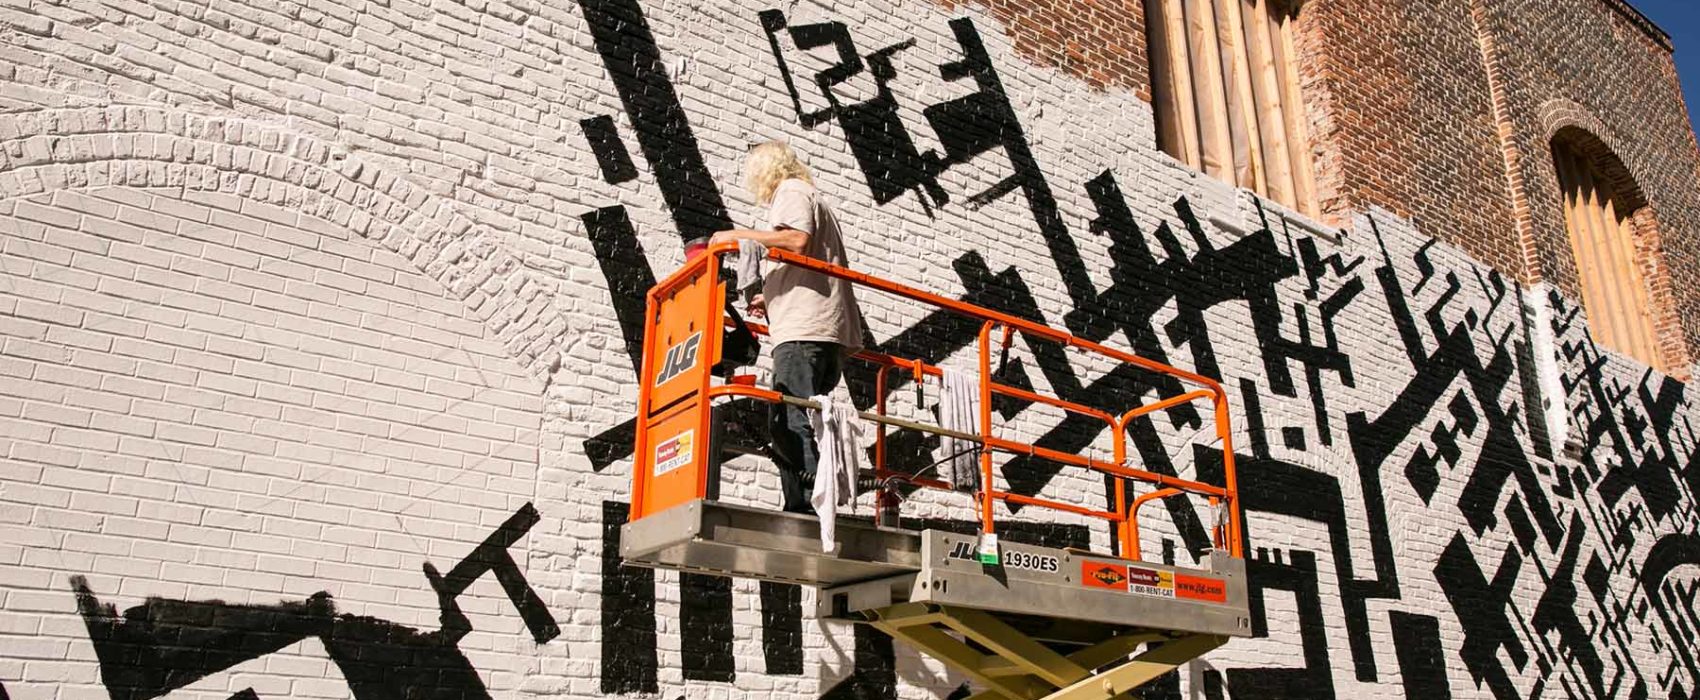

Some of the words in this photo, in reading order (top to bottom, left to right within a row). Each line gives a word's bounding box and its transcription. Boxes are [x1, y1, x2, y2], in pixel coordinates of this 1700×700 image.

[656, 332, 702, 386] JLG
[949, 541, 980, 561] JL
[1004, 551, 1058, 572] 1930ES
